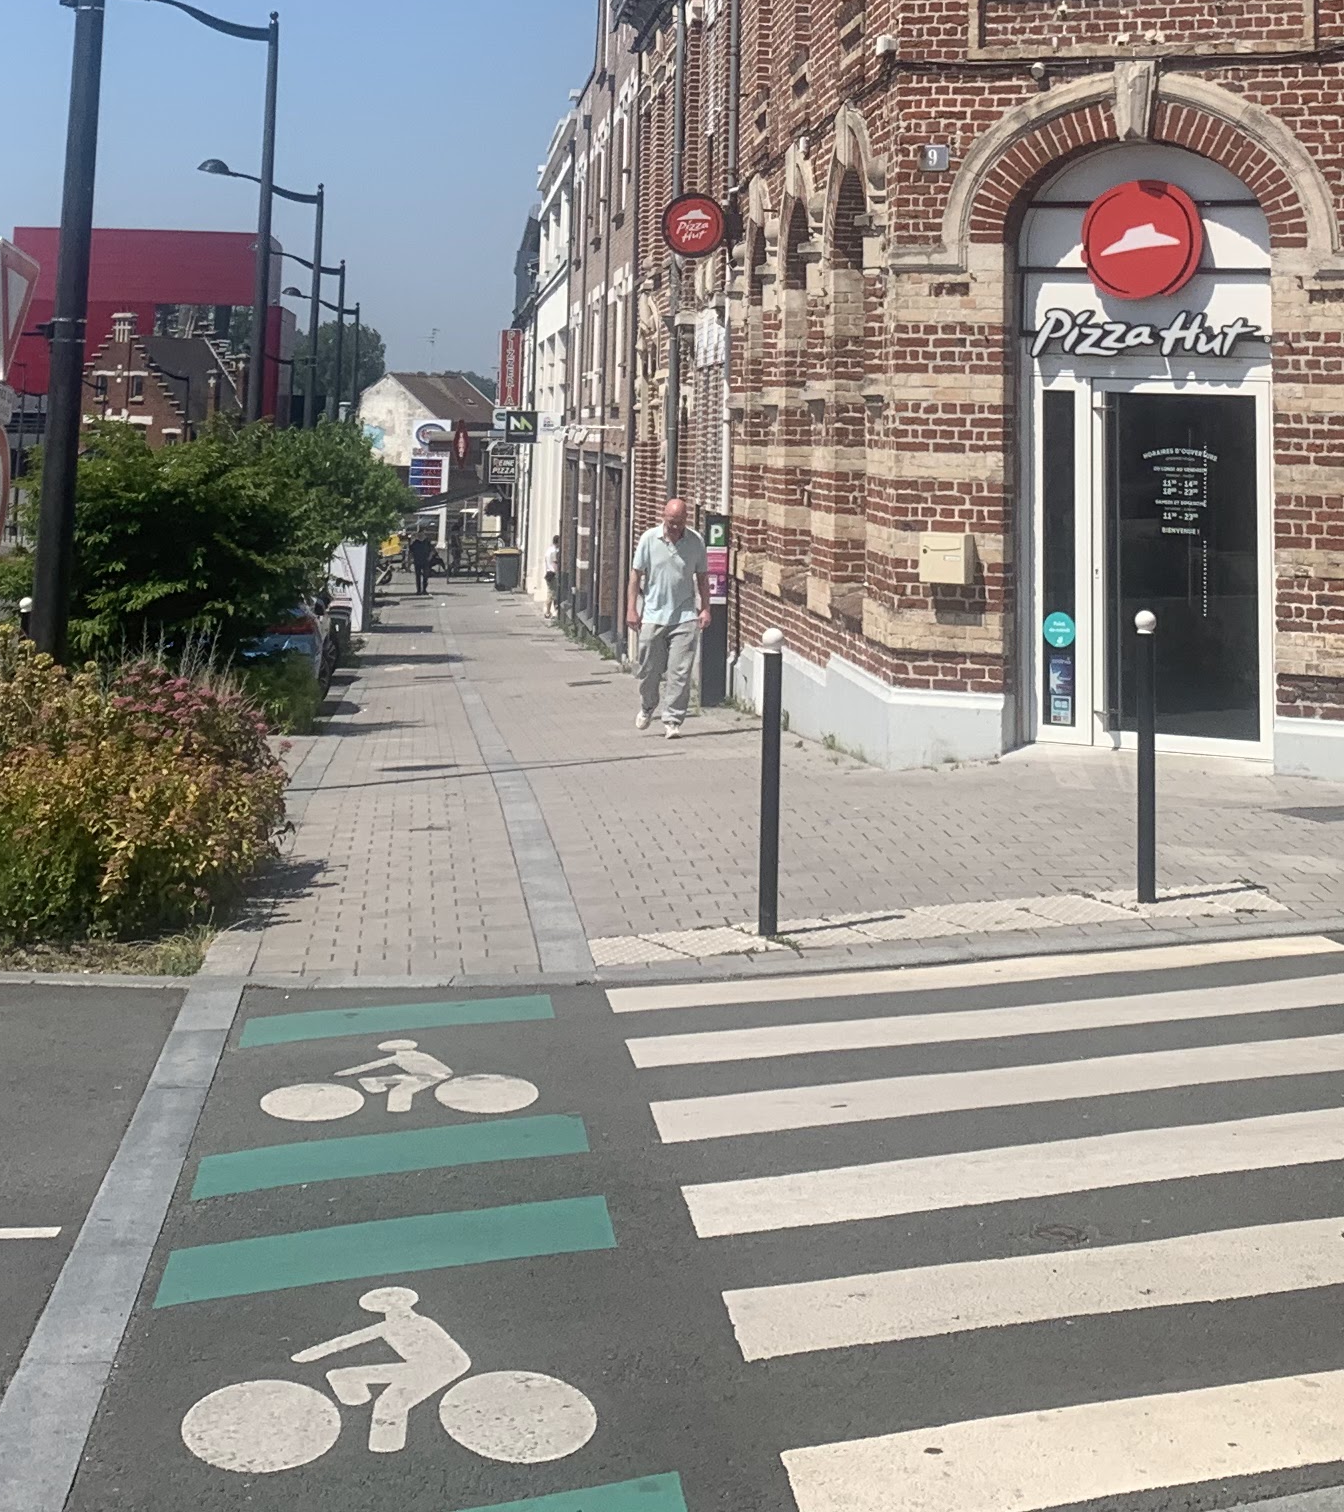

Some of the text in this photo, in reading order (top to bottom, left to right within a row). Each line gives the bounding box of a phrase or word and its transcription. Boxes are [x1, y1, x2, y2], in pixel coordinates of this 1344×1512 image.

[928, 149, 937, 166] 9
[676, 220, 709, 235] Pizza
[682, 230, 708, 243] Hut
[1031, 307, 1261, 357] Pizza Hut
[504, 330, 515, 405] PIZZERIA
[1143, 448, 1174, 459] HORAIRES
[710, 524, 723, 545] P
